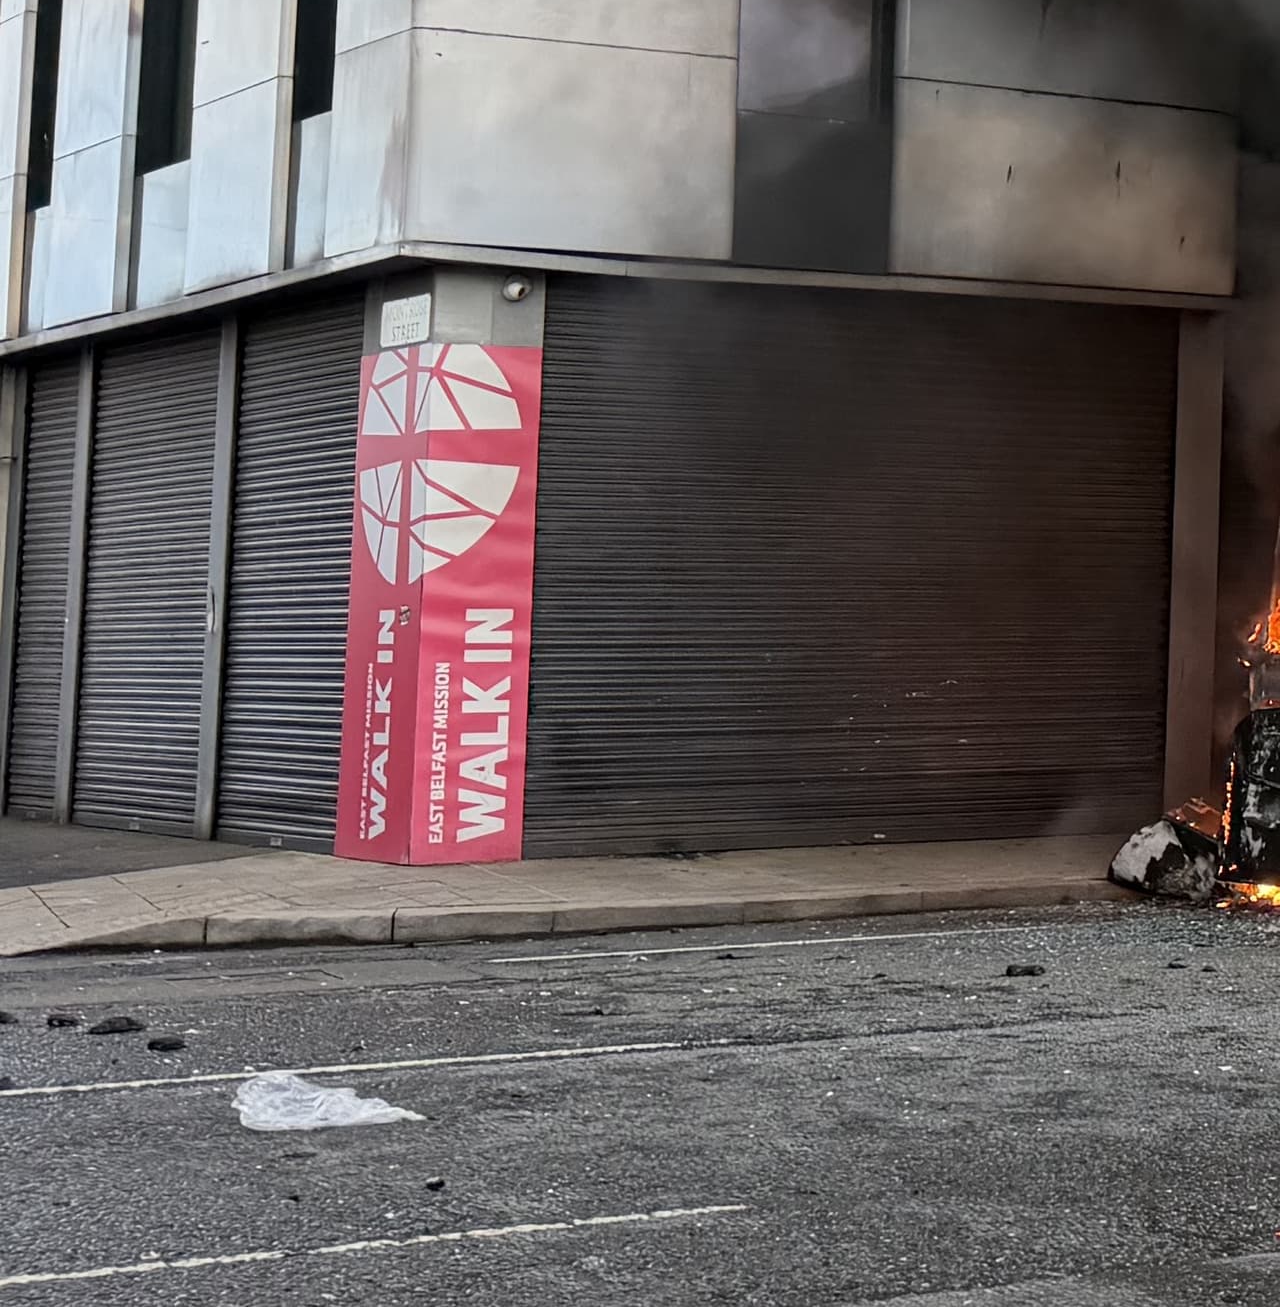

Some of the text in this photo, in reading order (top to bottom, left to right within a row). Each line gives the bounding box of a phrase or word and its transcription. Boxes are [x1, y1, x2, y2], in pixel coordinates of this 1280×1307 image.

[392, 322, 420, 341] STREET
[359, 662, 374, 839] EAST BELFAST MISSION
[367, 610, 395, 840] WALK IN
[428, 662, 451, 844] EAST BELFAST MISSION
[455, 609, 515, 843] WALK IN
